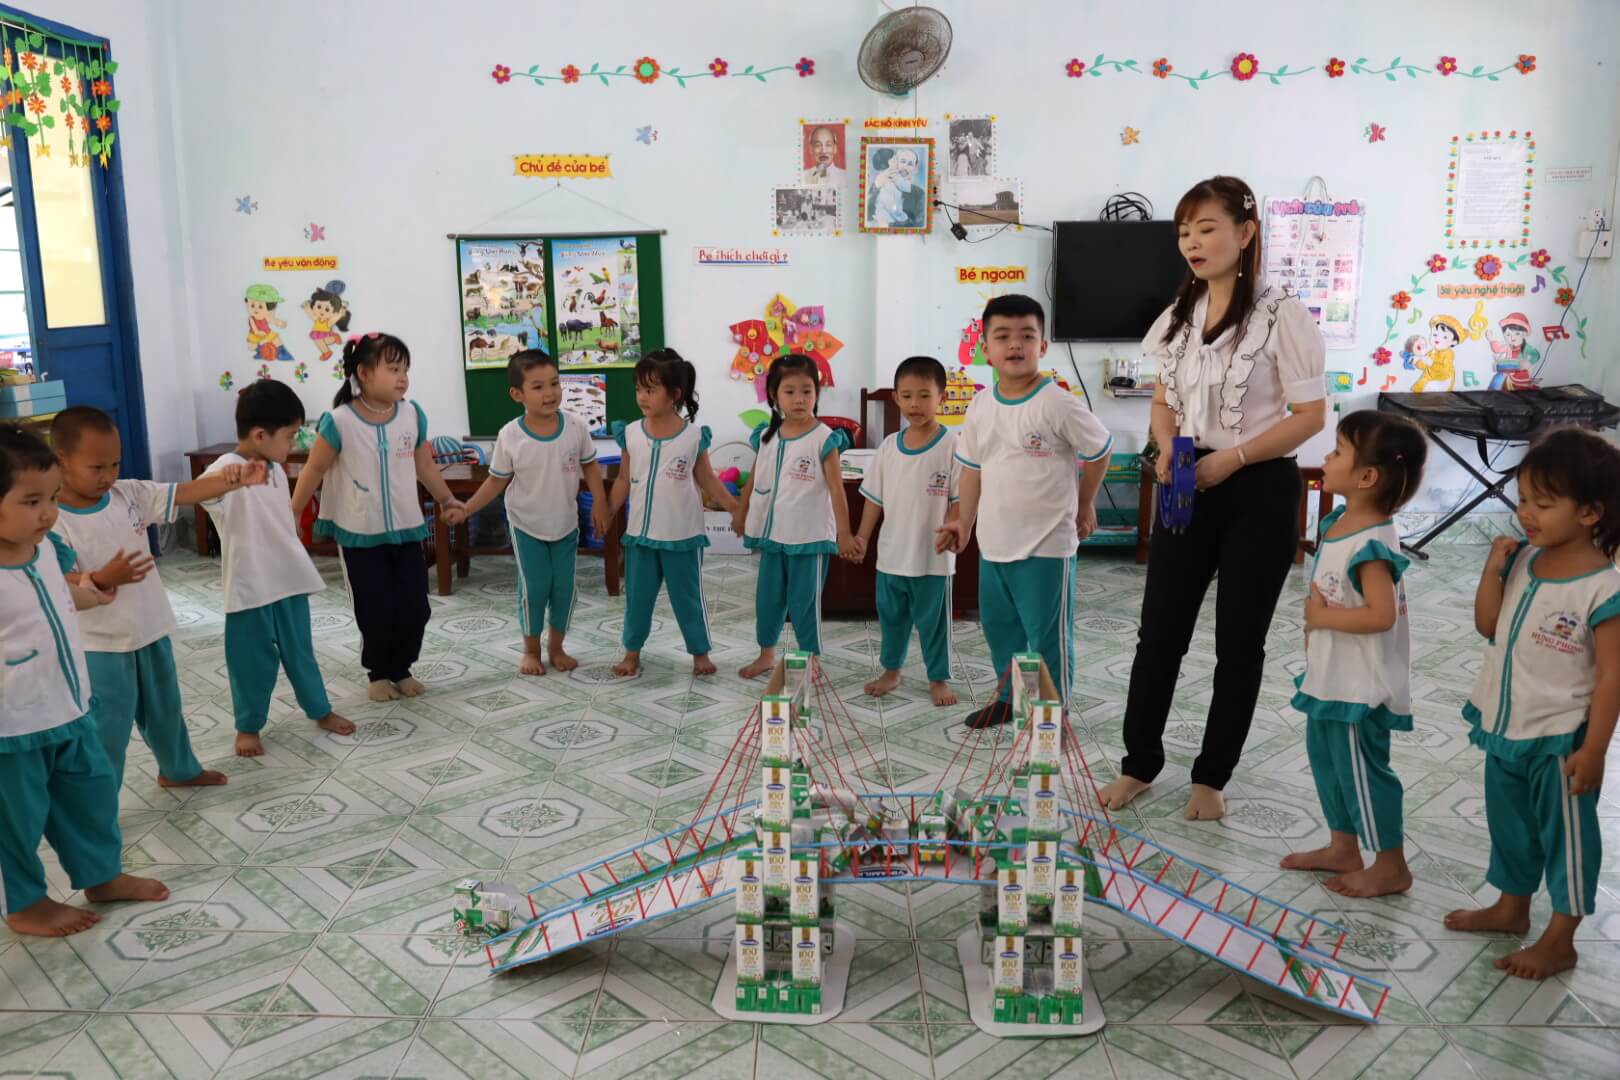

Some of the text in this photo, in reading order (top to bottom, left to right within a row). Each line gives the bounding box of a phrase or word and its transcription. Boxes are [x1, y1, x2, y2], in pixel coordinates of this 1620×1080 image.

[520, 160, 544, 173] Chủ
[564, 160, 587, 173] của
[590, 161, 606, 173] bé
[960, 267, 1025, 284] Bé ngoan
